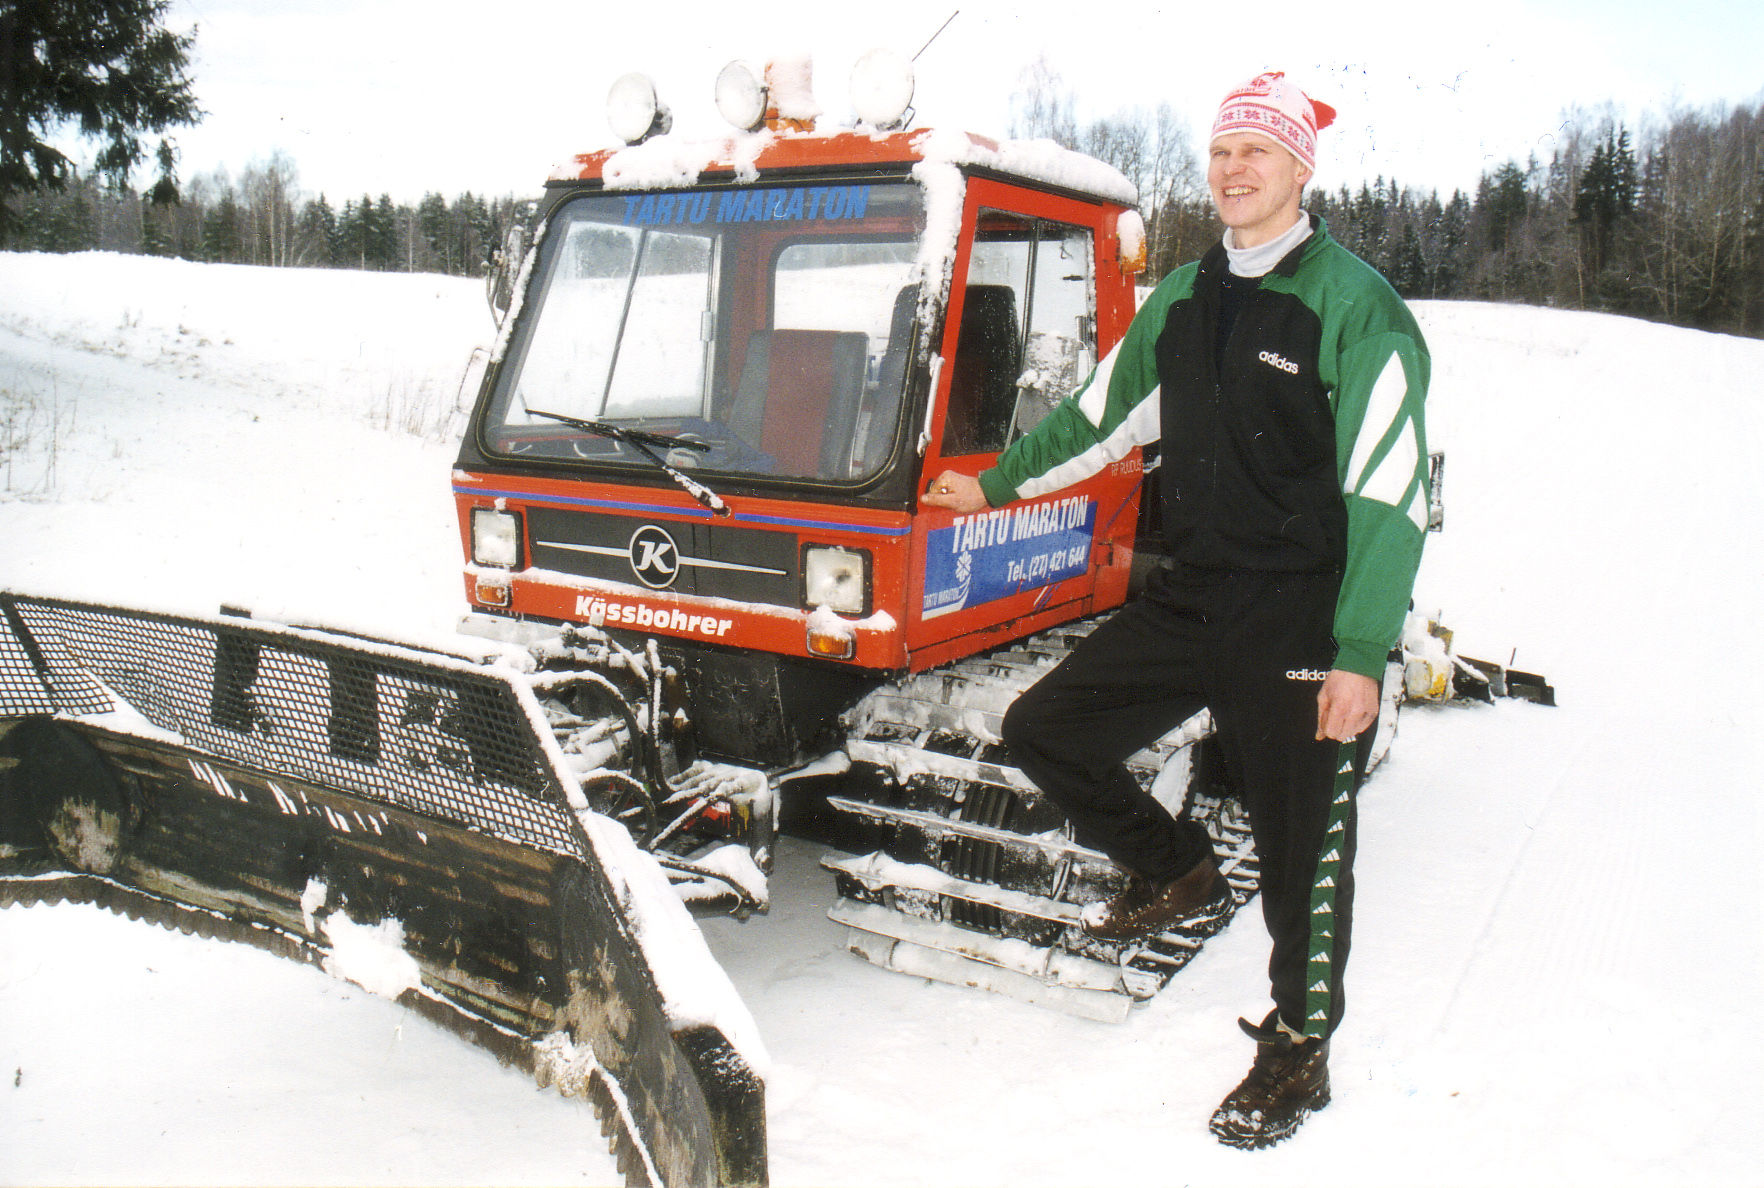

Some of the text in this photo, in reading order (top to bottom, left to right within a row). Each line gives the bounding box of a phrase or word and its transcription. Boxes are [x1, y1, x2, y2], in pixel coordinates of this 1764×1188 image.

[623, 185, 870, 226] TARTU MARATON
[1259, 350, 1299, 374] adidas
[952, 495, 1088, 554] TARTU MARATON
[1007, 545, 1085, 582] Tel. (27) 421 644
[575, 595, 733, 637] Kässbohrer
